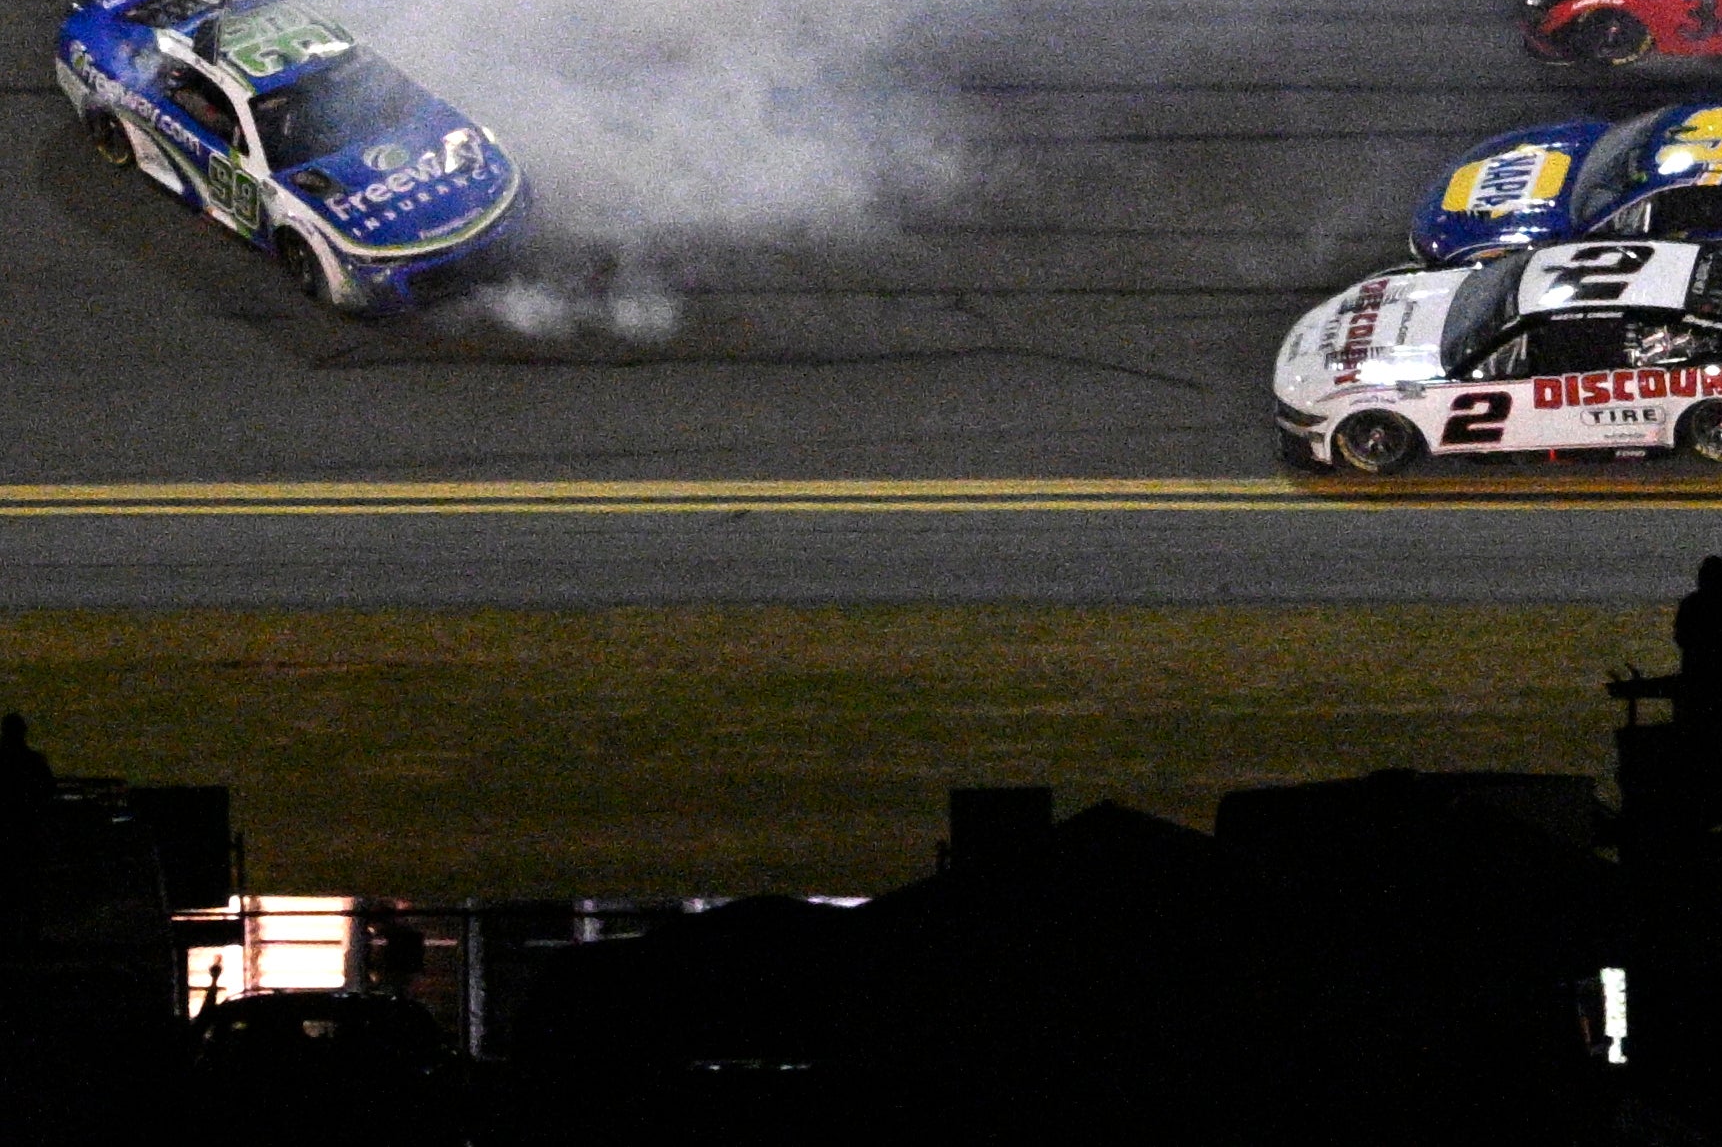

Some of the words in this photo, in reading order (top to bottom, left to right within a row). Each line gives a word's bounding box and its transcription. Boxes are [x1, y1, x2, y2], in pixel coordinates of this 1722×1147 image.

[324, 130, 488, 222] Freewy
[1472, 152, 1539, 210] NAPA
[1441, 391, 1512, 447] 2
[1588, 406, 1659, 426] TIRE
